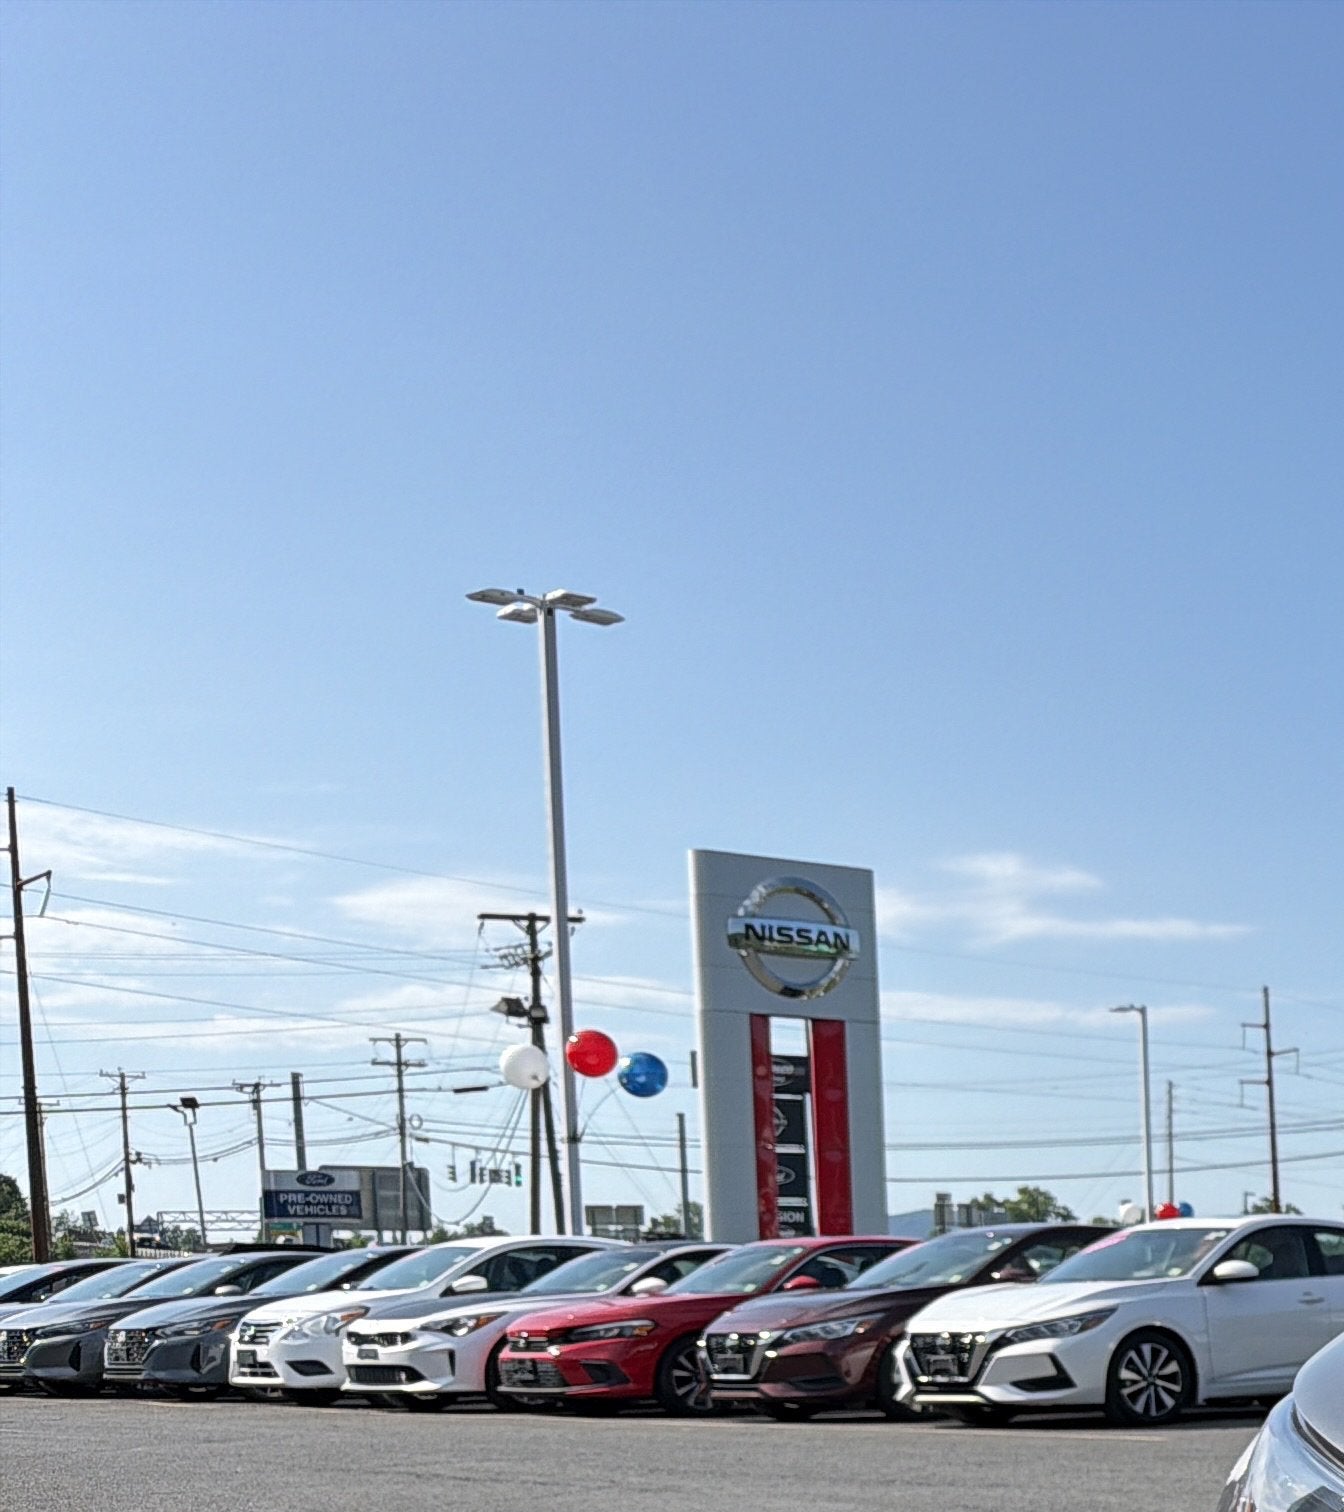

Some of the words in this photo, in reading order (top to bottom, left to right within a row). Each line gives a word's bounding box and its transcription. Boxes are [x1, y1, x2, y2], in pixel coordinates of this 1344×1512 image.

[744, 923, 850, 949] NISSAN
[280, 1193, 353, 1204] PRE-OWNED
[288, 1205, 347, 1215] VEHICLES
